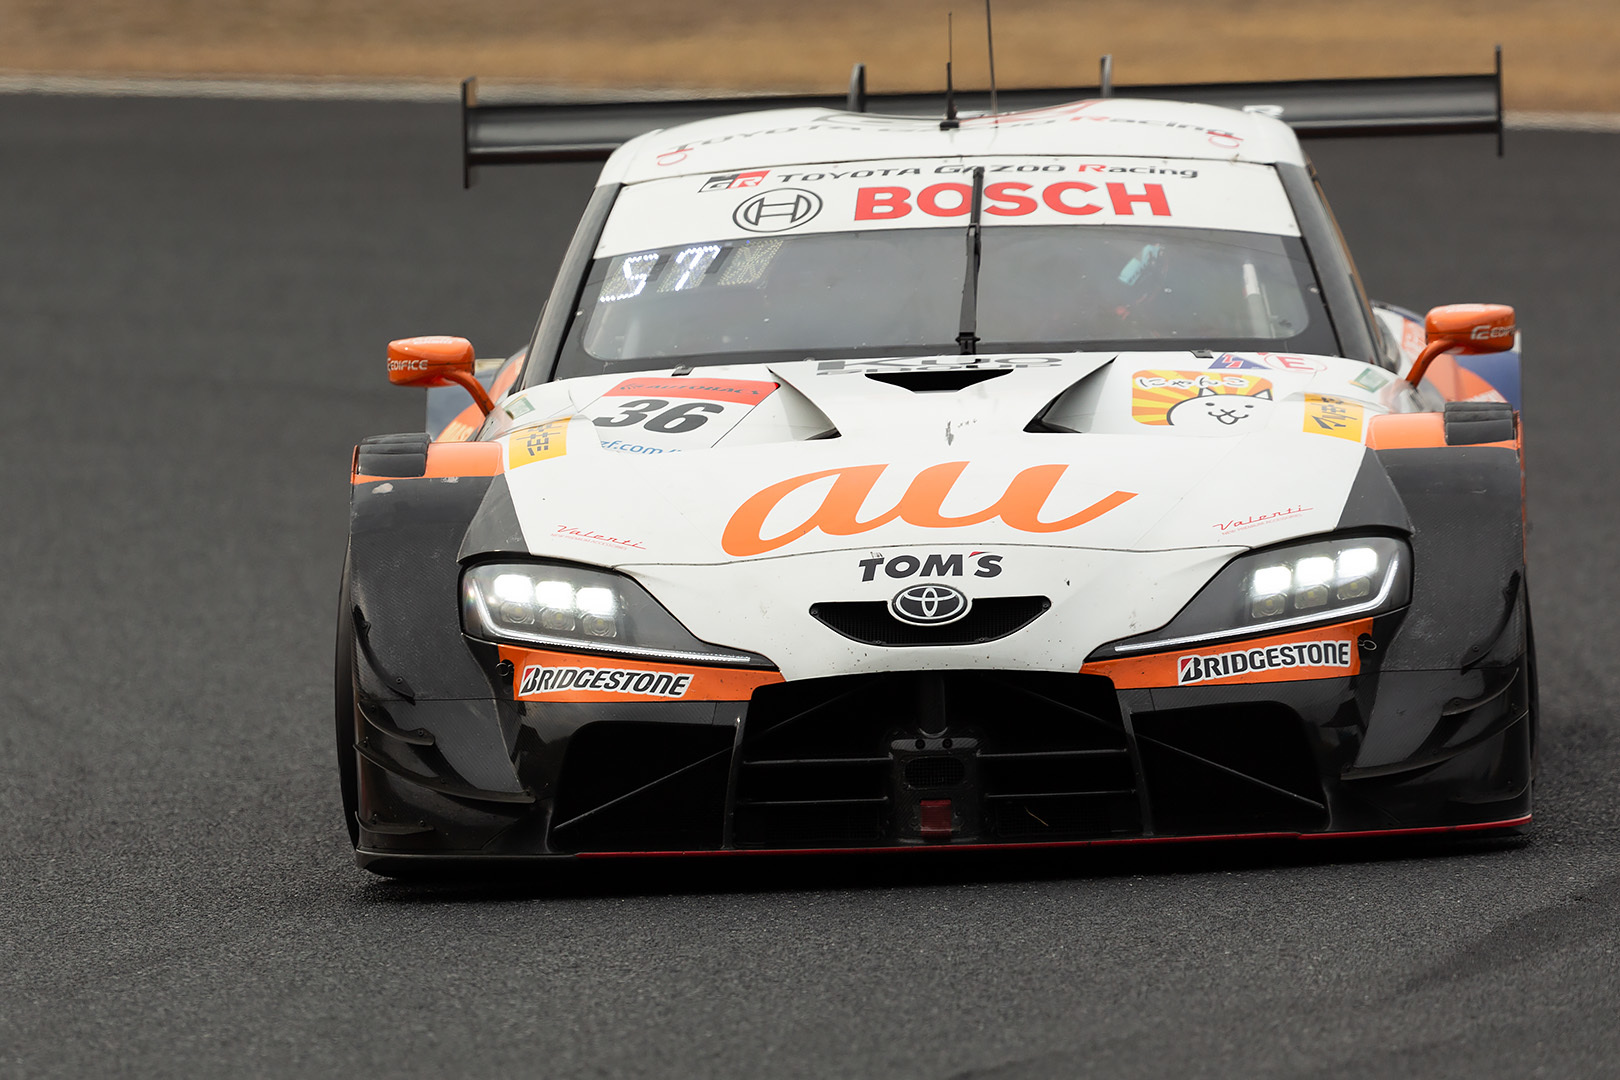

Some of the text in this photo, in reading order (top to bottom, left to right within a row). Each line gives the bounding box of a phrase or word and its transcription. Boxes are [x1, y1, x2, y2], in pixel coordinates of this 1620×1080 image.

[777, 168, 921, 183] TOYOTA
[1078, 164, 1198, 178] Racing
[854, 181, 1172, 221] BOSCH
[592, 399, 724, 433] 36
[722, 461, 1139, 557] au
[1212, 505, 1313, 531] Valenti
[557, 524, 646, 550] Valenti
[1180, 642, 1350, 683] BRIDGESTONE
[519, 667, 691, 697] BRIDGESTONE
